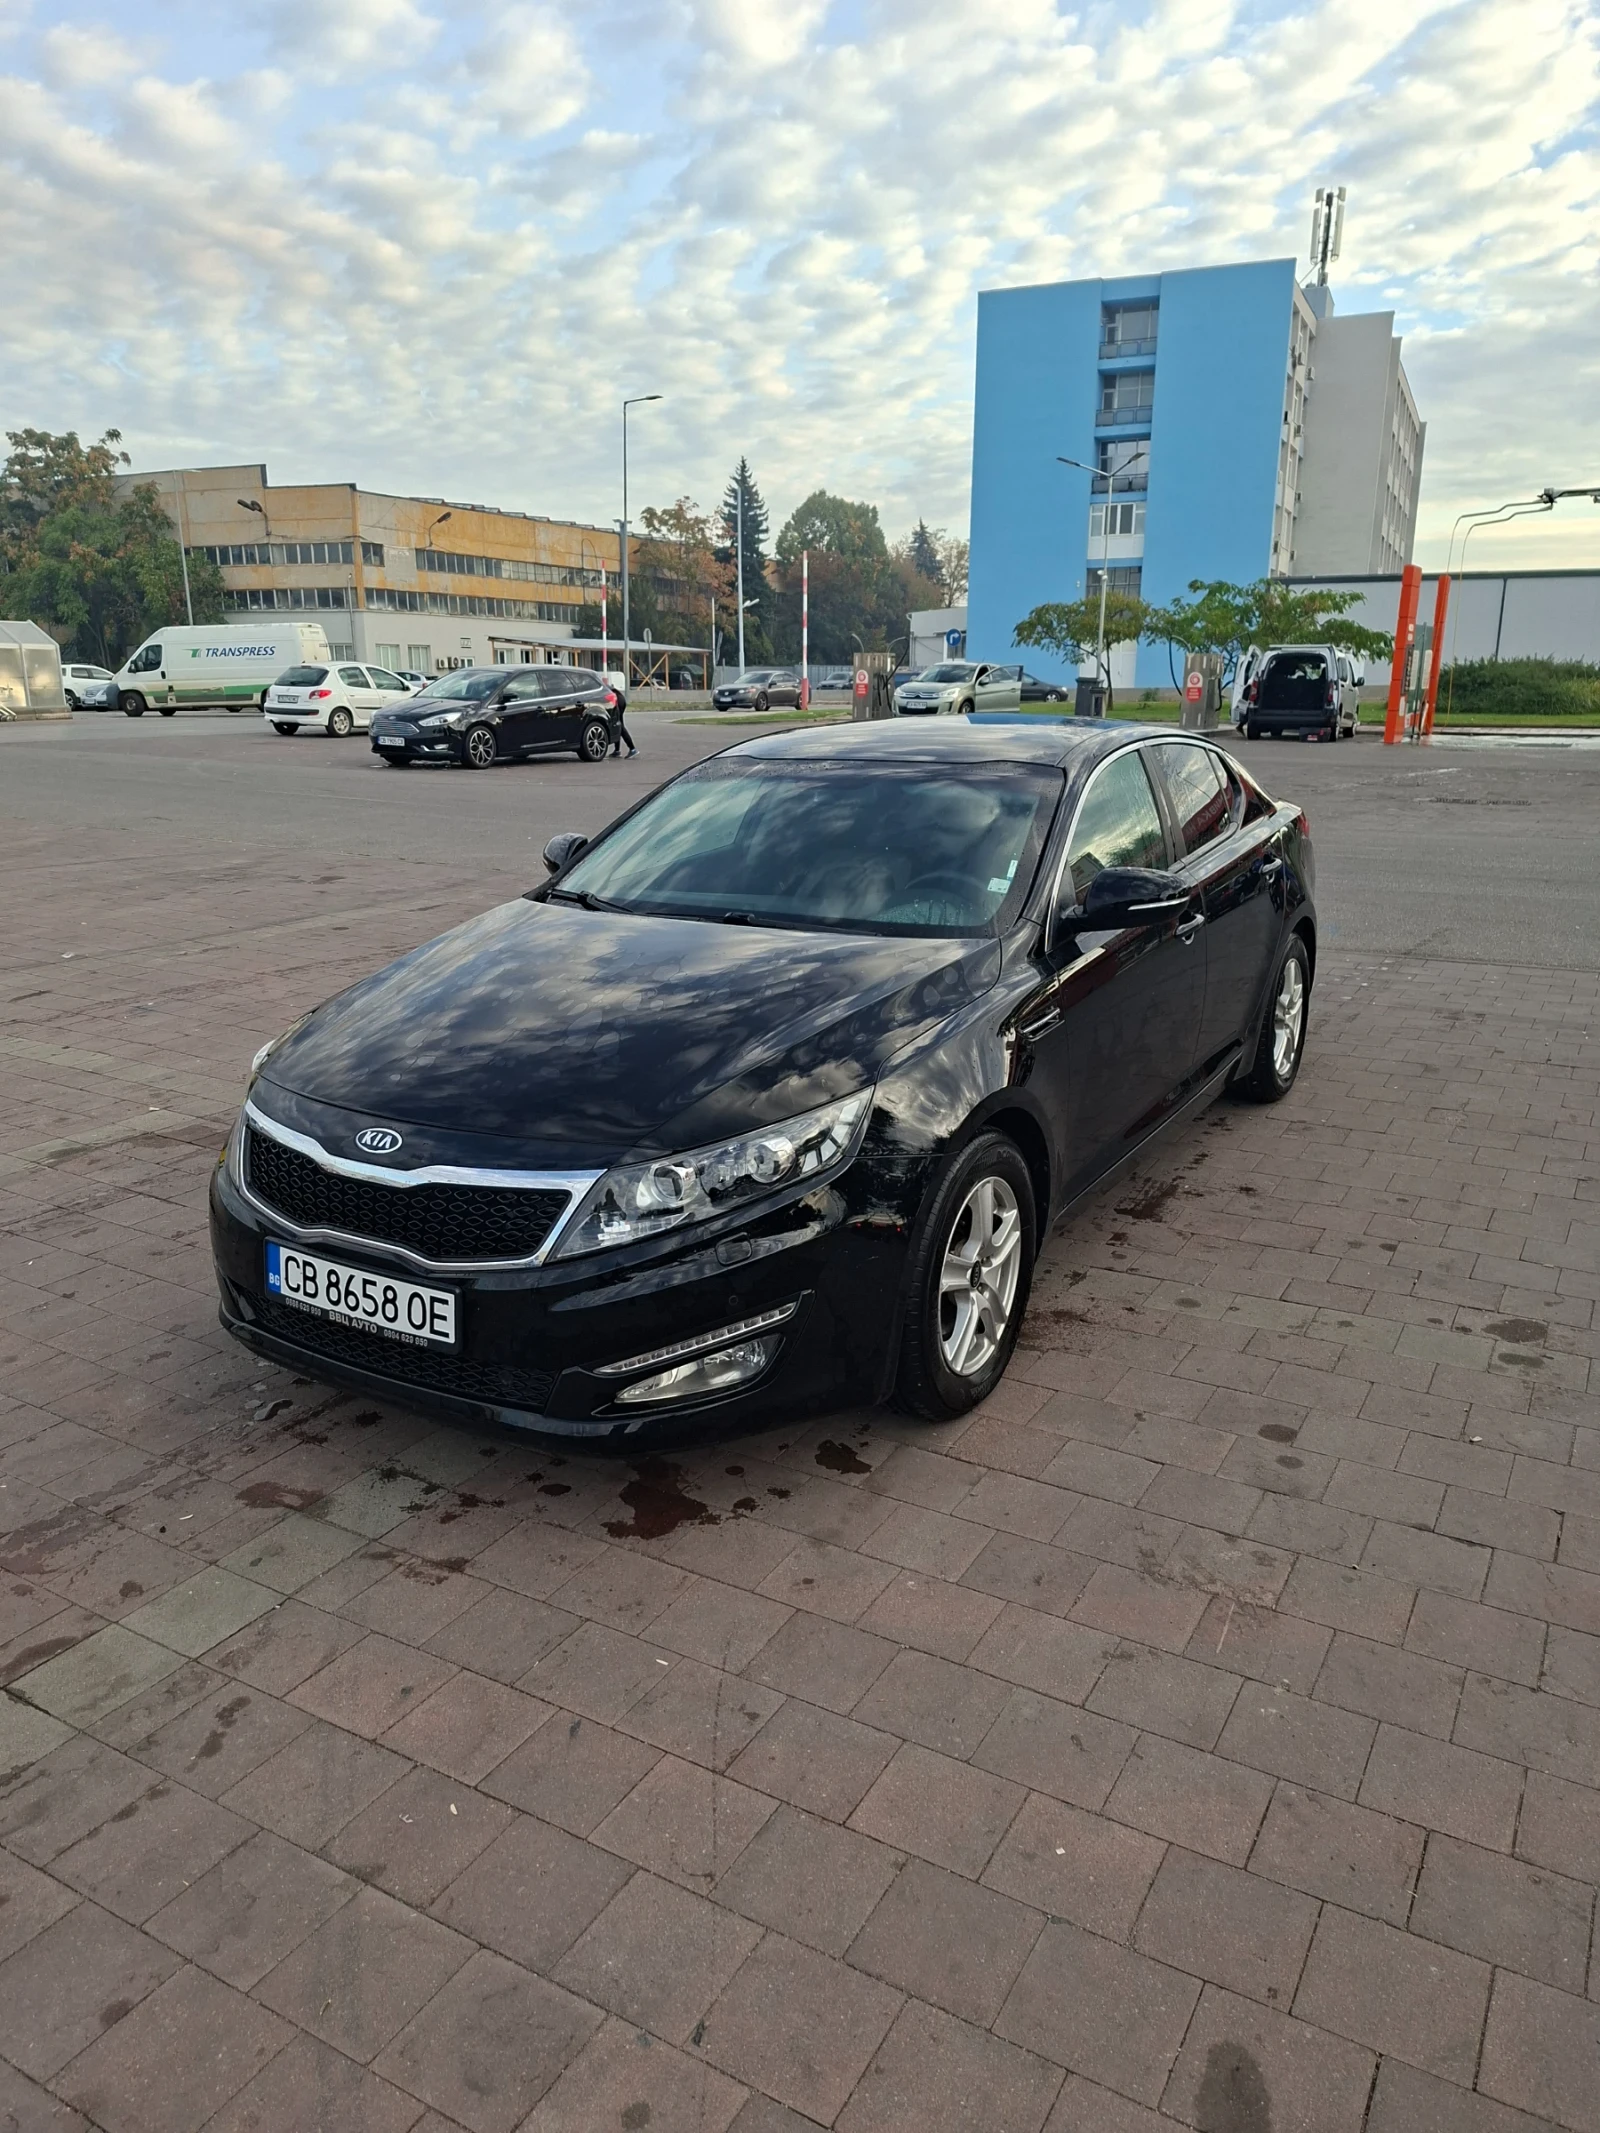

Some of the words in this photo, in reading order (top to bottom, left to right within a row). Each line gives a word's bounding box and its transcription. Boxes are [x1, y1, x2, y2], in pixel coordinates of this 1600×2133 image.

[205, 646, 276, 658] TRANSPRESS
[361, 1131, 393, 1149] KIA
[269, 1272, 280, 1286] BG
[285, 1255, 318, 1299] CB
[325, 1268, 399, 1323] 8658
[407, 1291, 450, 1338] OE
[351, 1318, 378, 1334] АУТО
